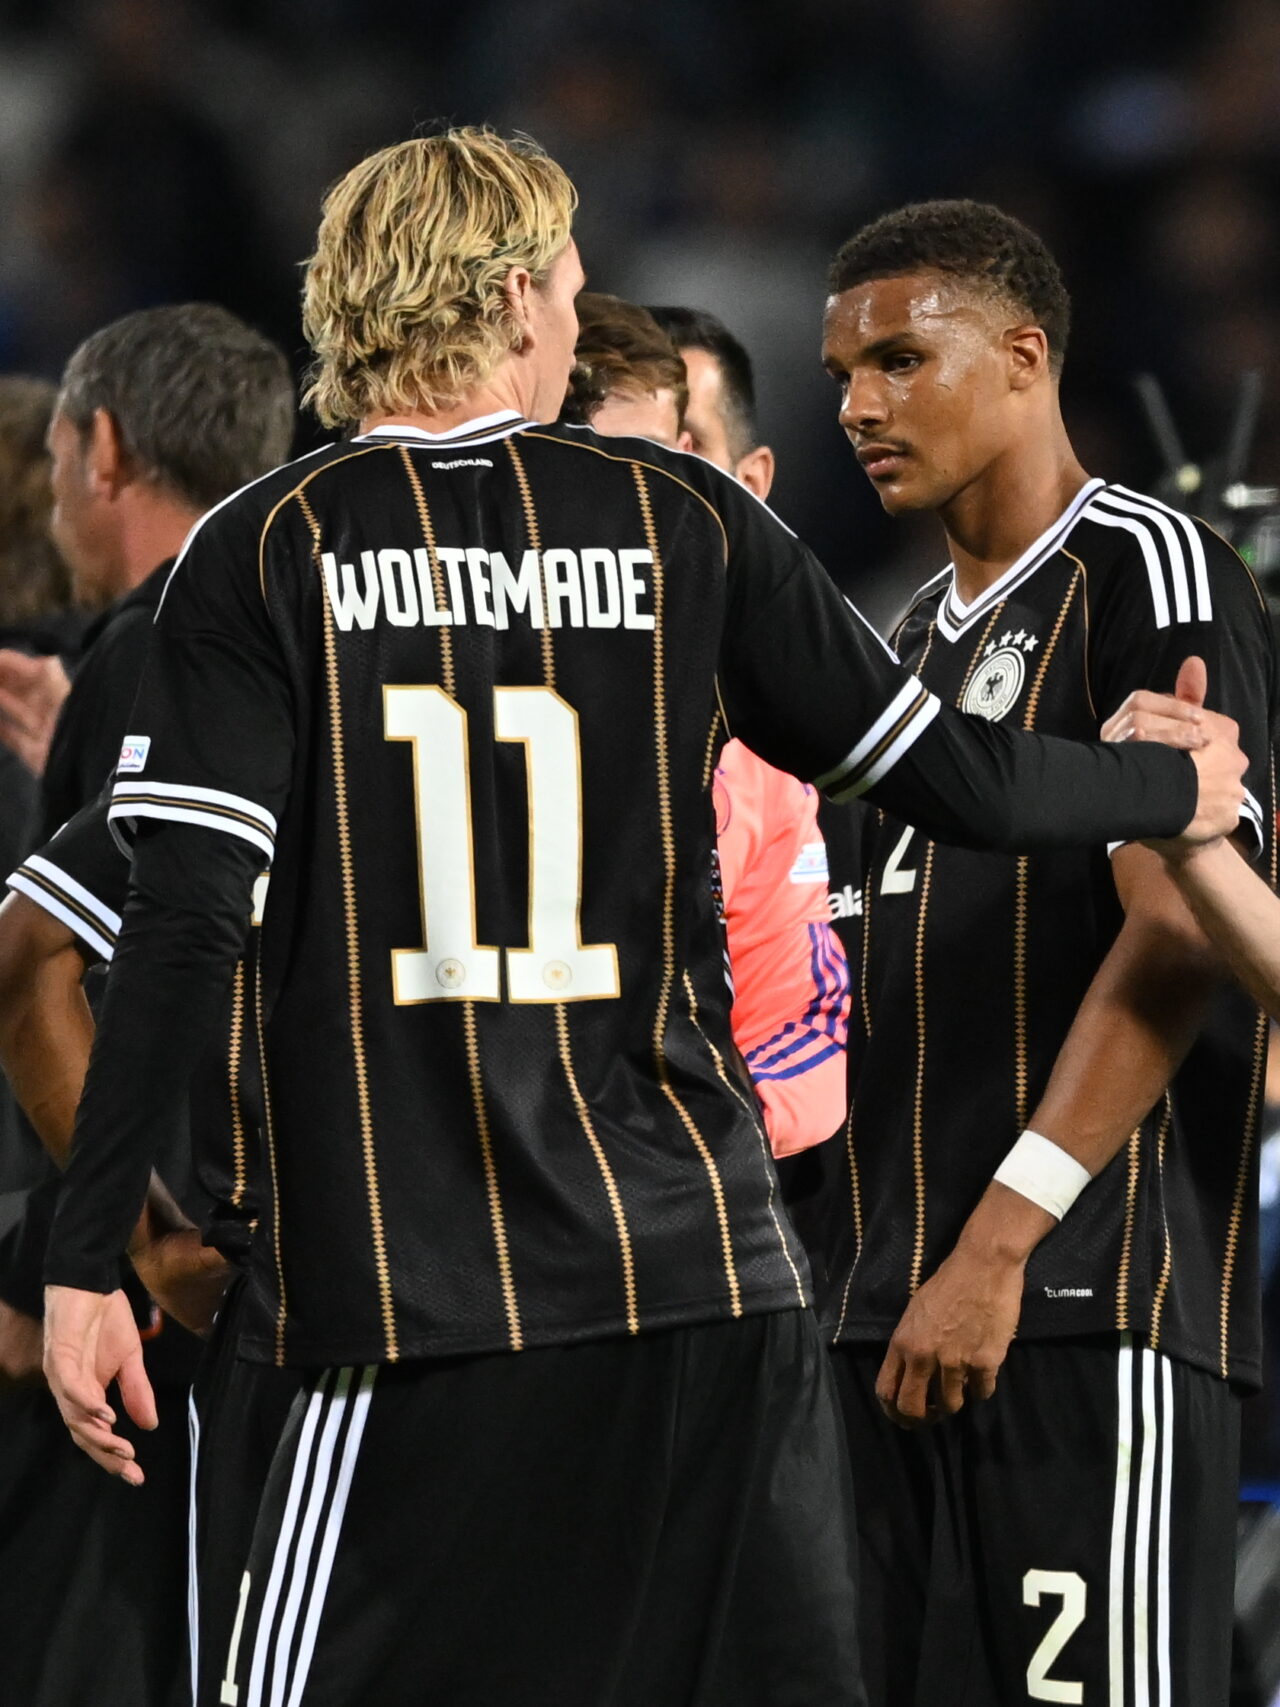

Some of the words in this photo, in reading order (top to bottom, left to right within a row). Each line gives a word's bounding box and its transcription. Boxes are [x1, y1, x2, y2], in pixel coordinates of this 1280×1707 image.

[431, 458, 494, 470] DEUTSCHLAND
[321, 547, 656, 632] WOLTEMADE
[382, 684, 621, 1006] 11
[1023, 1568, 1087, 1705] 2
